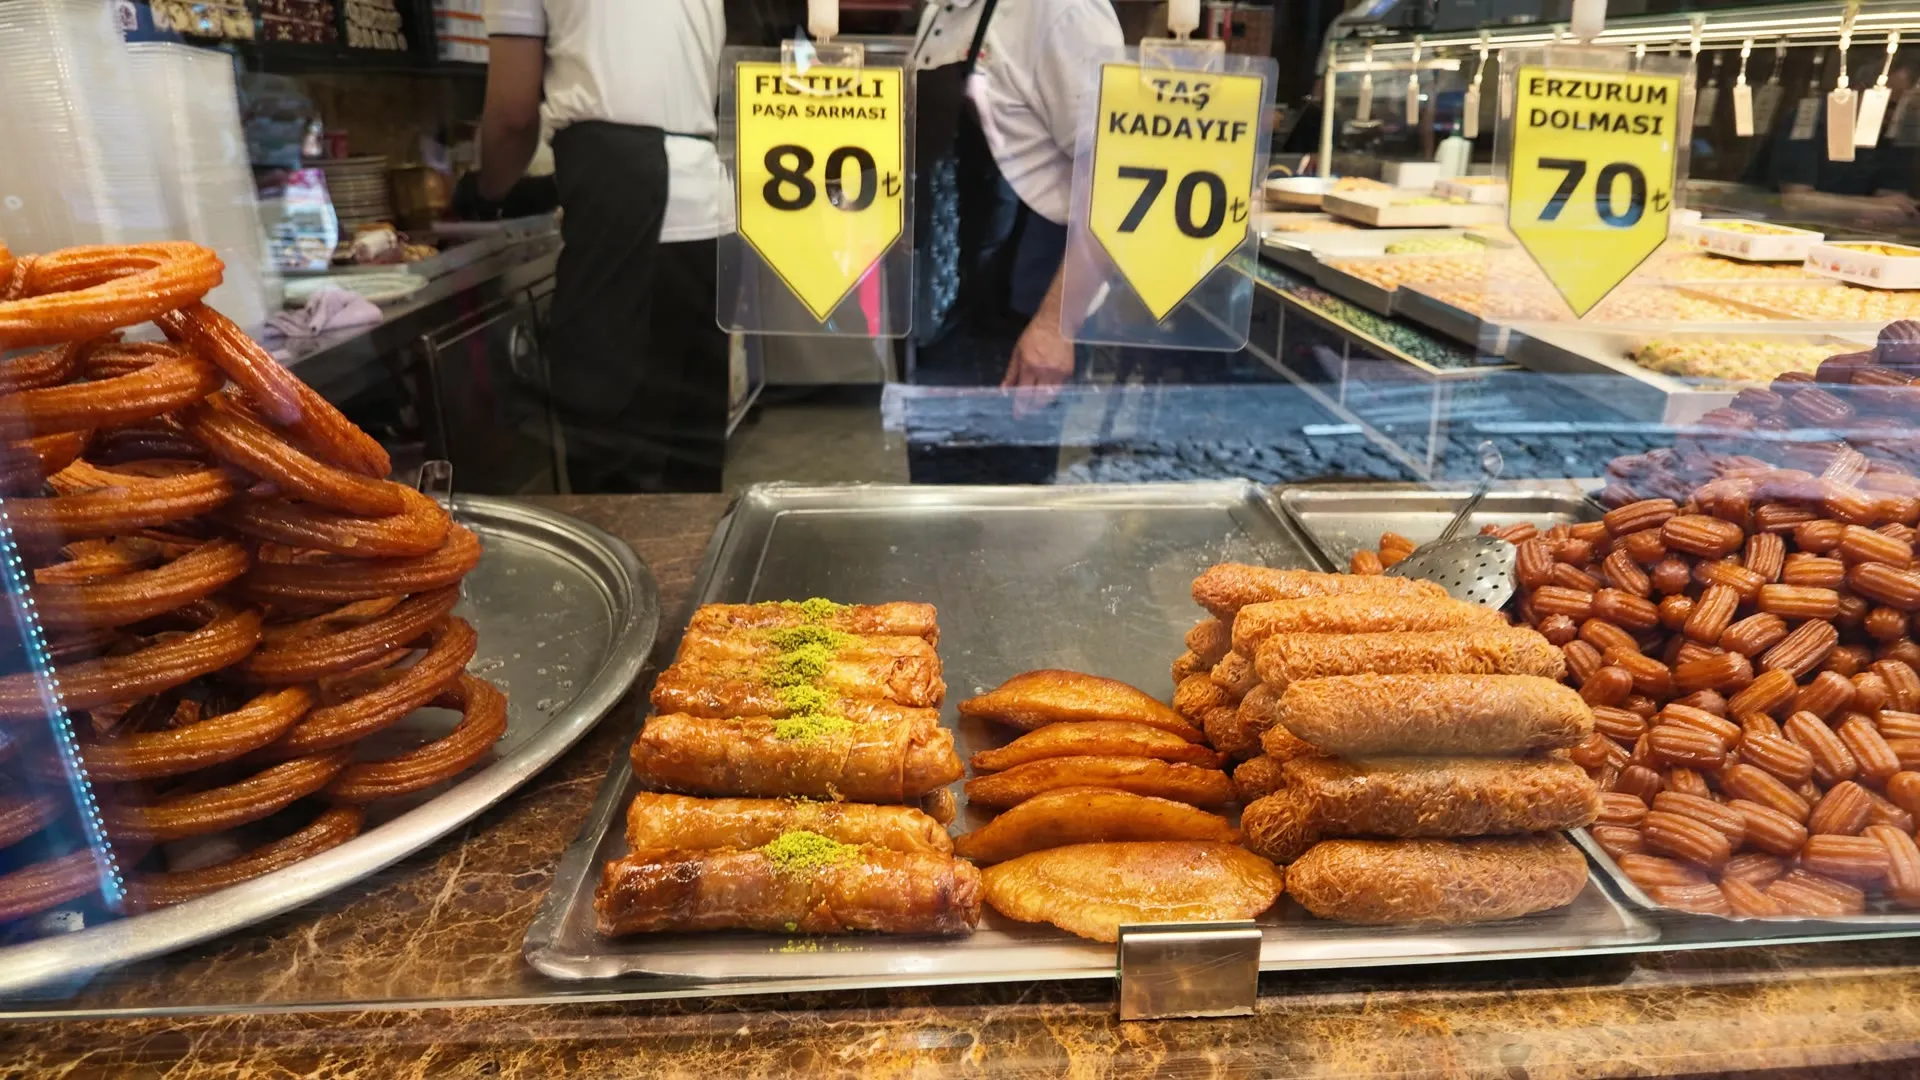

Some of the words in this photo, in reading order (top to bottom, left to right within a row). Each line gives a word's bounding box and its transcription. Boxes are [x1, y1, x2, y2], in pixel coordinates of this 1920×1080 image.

[755, 75, 883, 98] FISTIKLI
[1153, 79, 1210, 110] TAŞ
[1529, 78, 1668, 105] ERZURUM
[752, 104, 799, 119] PAŞA
[805, 106, 887, 120] SARMASI
[1529, 108, 1664, 136] DOLMASI
[1109, 111, 1248, 142] KADAYIF
